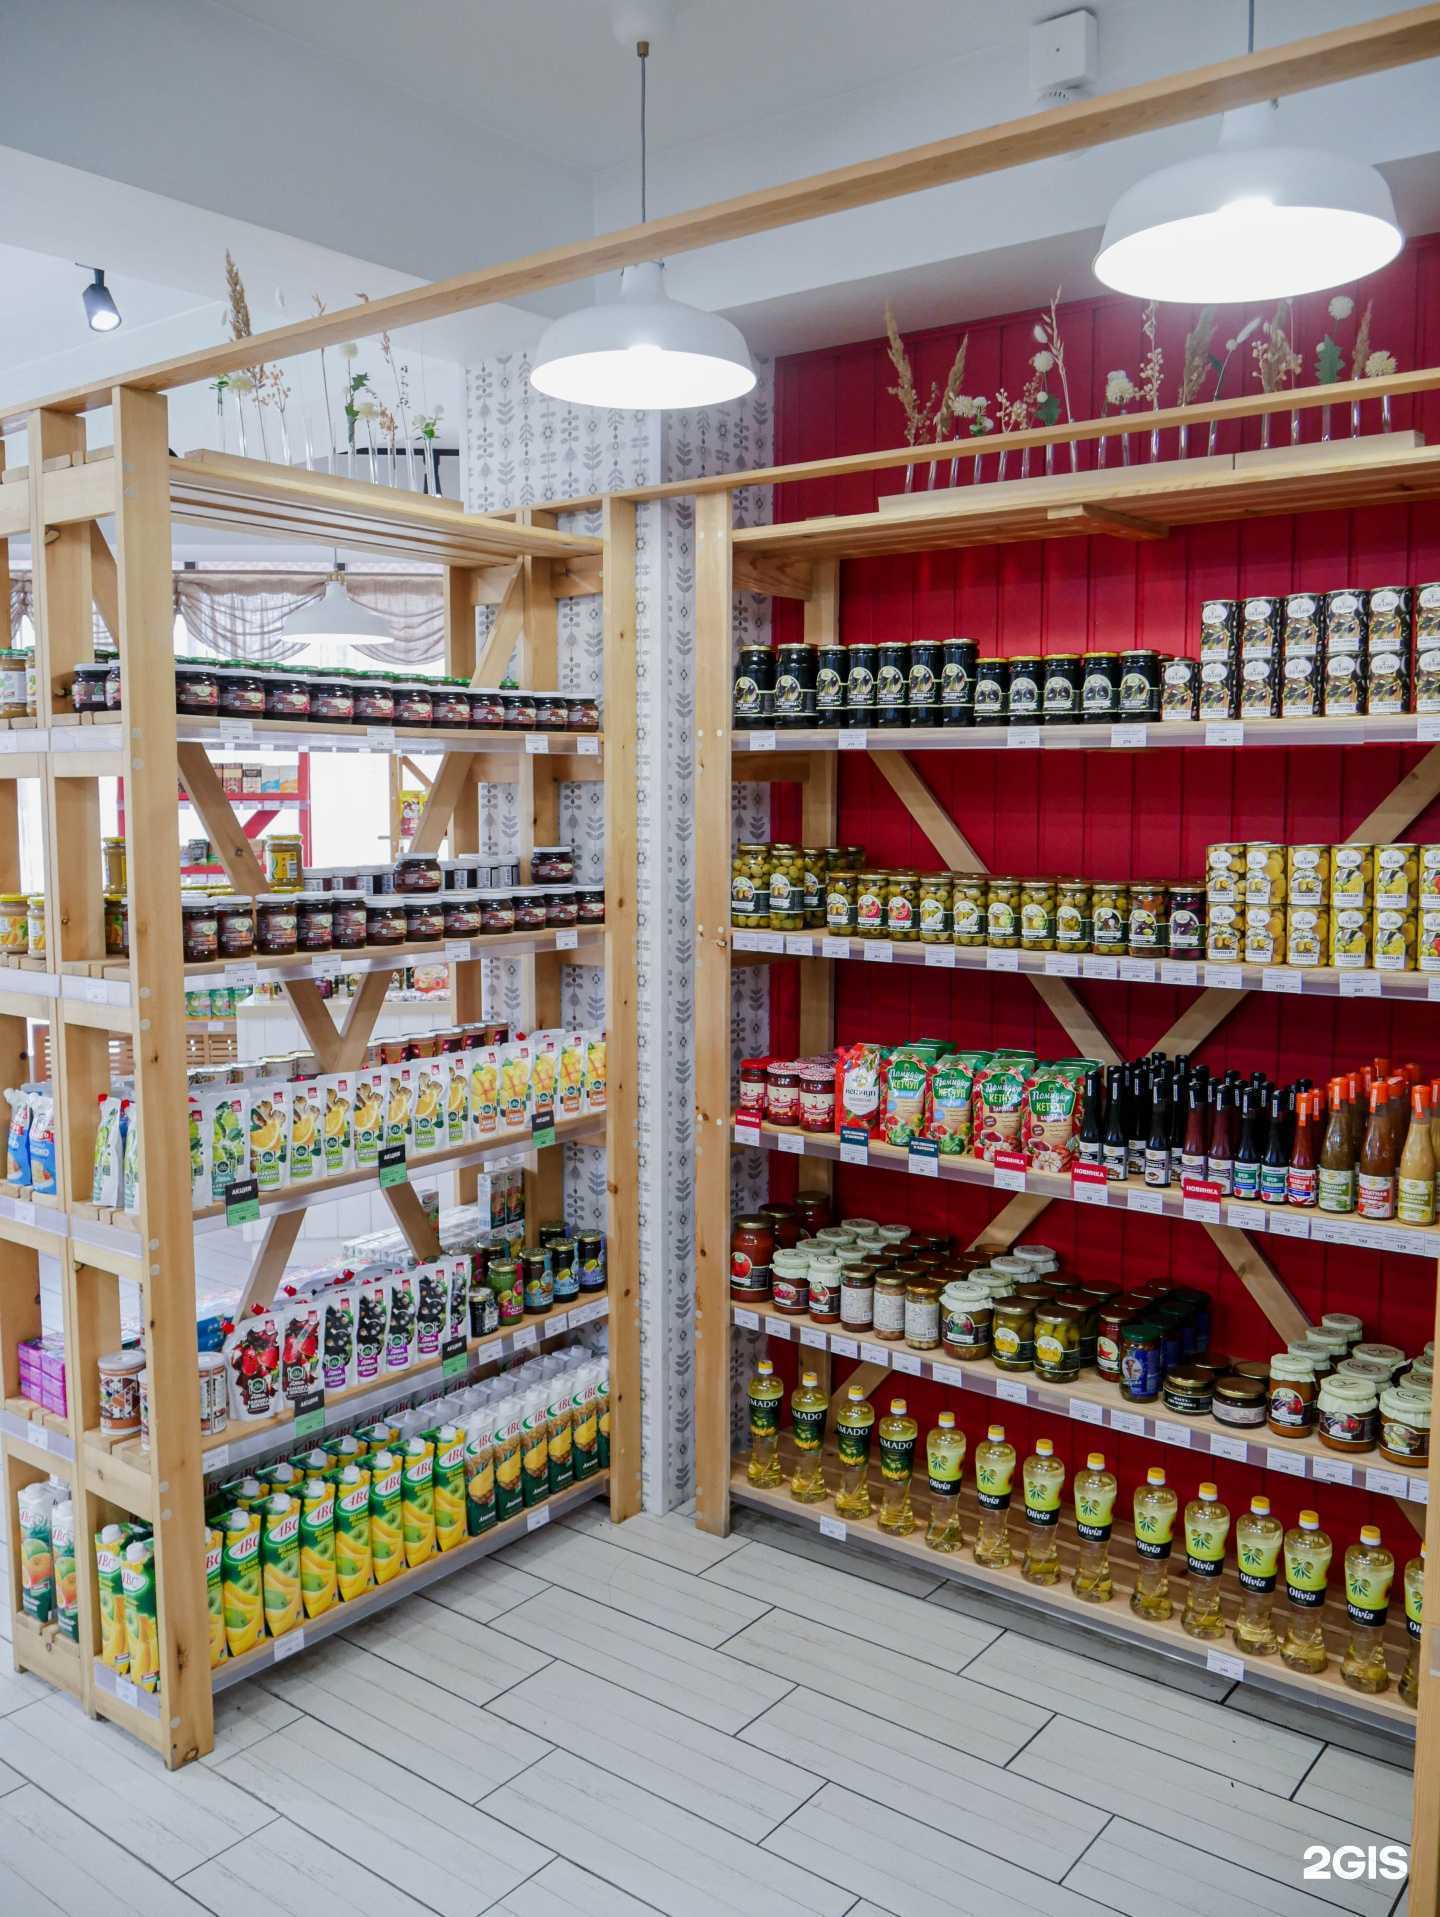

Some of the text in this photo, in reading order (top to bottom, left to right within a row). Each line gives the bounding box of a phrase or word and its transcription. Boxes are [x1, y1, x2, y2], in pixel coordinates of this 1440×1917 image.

[892, 1078, 919, 1090] КЕТЧУП
[996, 1156, 1024, 1166] НОВИНКА
[1074, 1167, 1104, 1178] НОВИНКА
[231, 1186, 252, 1195] АКЦИЯ
[1186, 1184, 1218, 1196] НОВИНКА
[793, 1411, 823, 1421] AMADO
[838, 1424, 869, 1436] AMADO
[881, 1438, 914, 1450] AMADO
[447, 1448, 464, 1463] ABC
[929, 1479, 952, 1491] Olivia
[978, 1493, 1001, 1505] Olivia
[1026, 1509, 1051, 1521] Olivia
[1078, 1524, 1103, 1537] Olivia
[235, 1535, 258, 1555] ABC
[1136, 1541, 1162, 1555] Olivia
[98, 1554, 115, 1569] ABC
[1188, 1558, 1215, 1571] Olivia
[1240, 1573, 1267, 1587] Olivia
[1288, 1587, 1317, 1602] Olivia
[1347, 1604, 1375, 1620] Olivia
[1409, 1621, 1424, 1633] Oli
